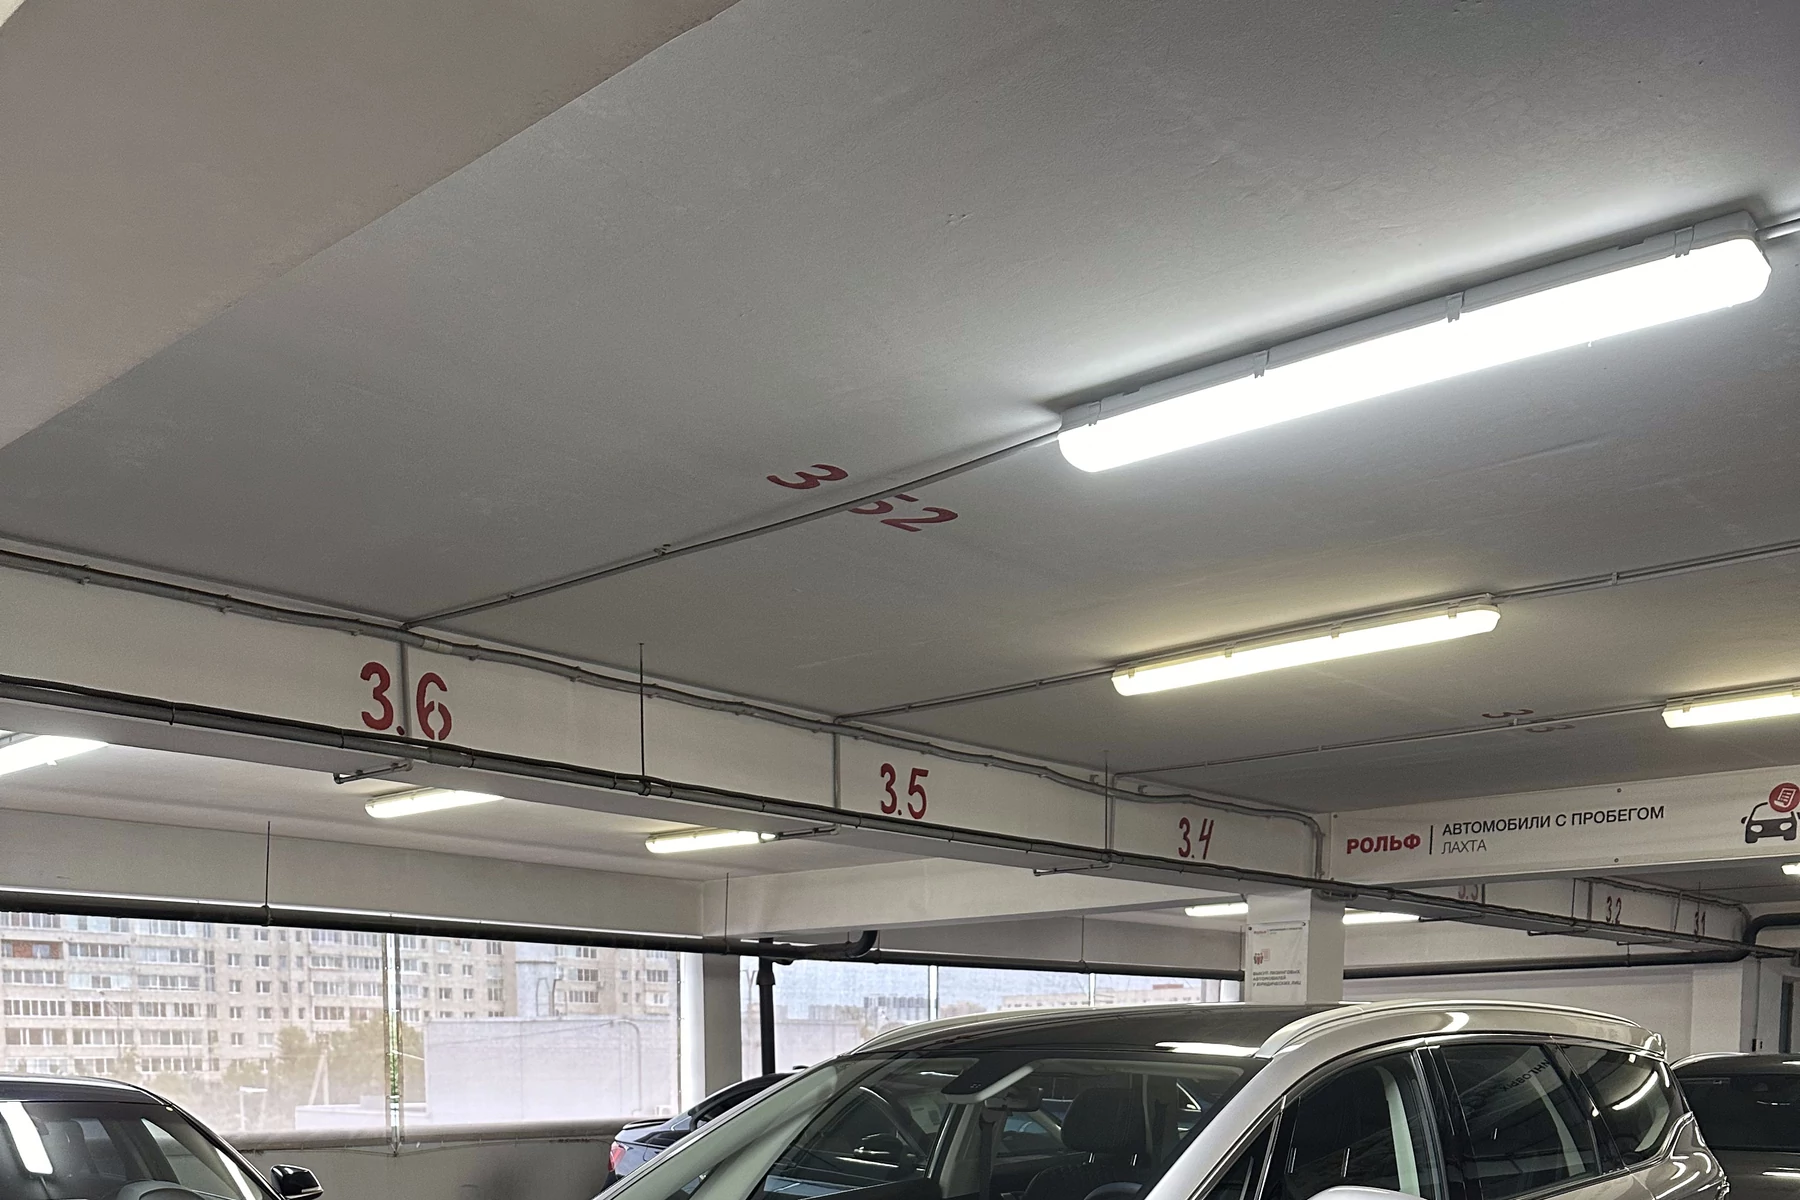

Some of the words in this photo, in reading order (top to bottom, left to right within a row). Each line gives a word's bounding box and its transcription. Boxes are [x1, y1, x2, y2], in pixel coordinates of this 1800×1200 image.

[360, 661, 452, 741] 3.6
[880, 763, 929, 820] 3.5
[1178, 817, 1215, 860] 3.4
[1442, 815, 1550, 836] АВТОМОБИЛИ
[1555, 814, 1567, 827] С
[1571, 806, 1665, 826] ПРОБЕГОМ
[1346, 833, 1421, 854] РОЛЬФ
[1441, 839, 1487, 855] ЛАХТА
